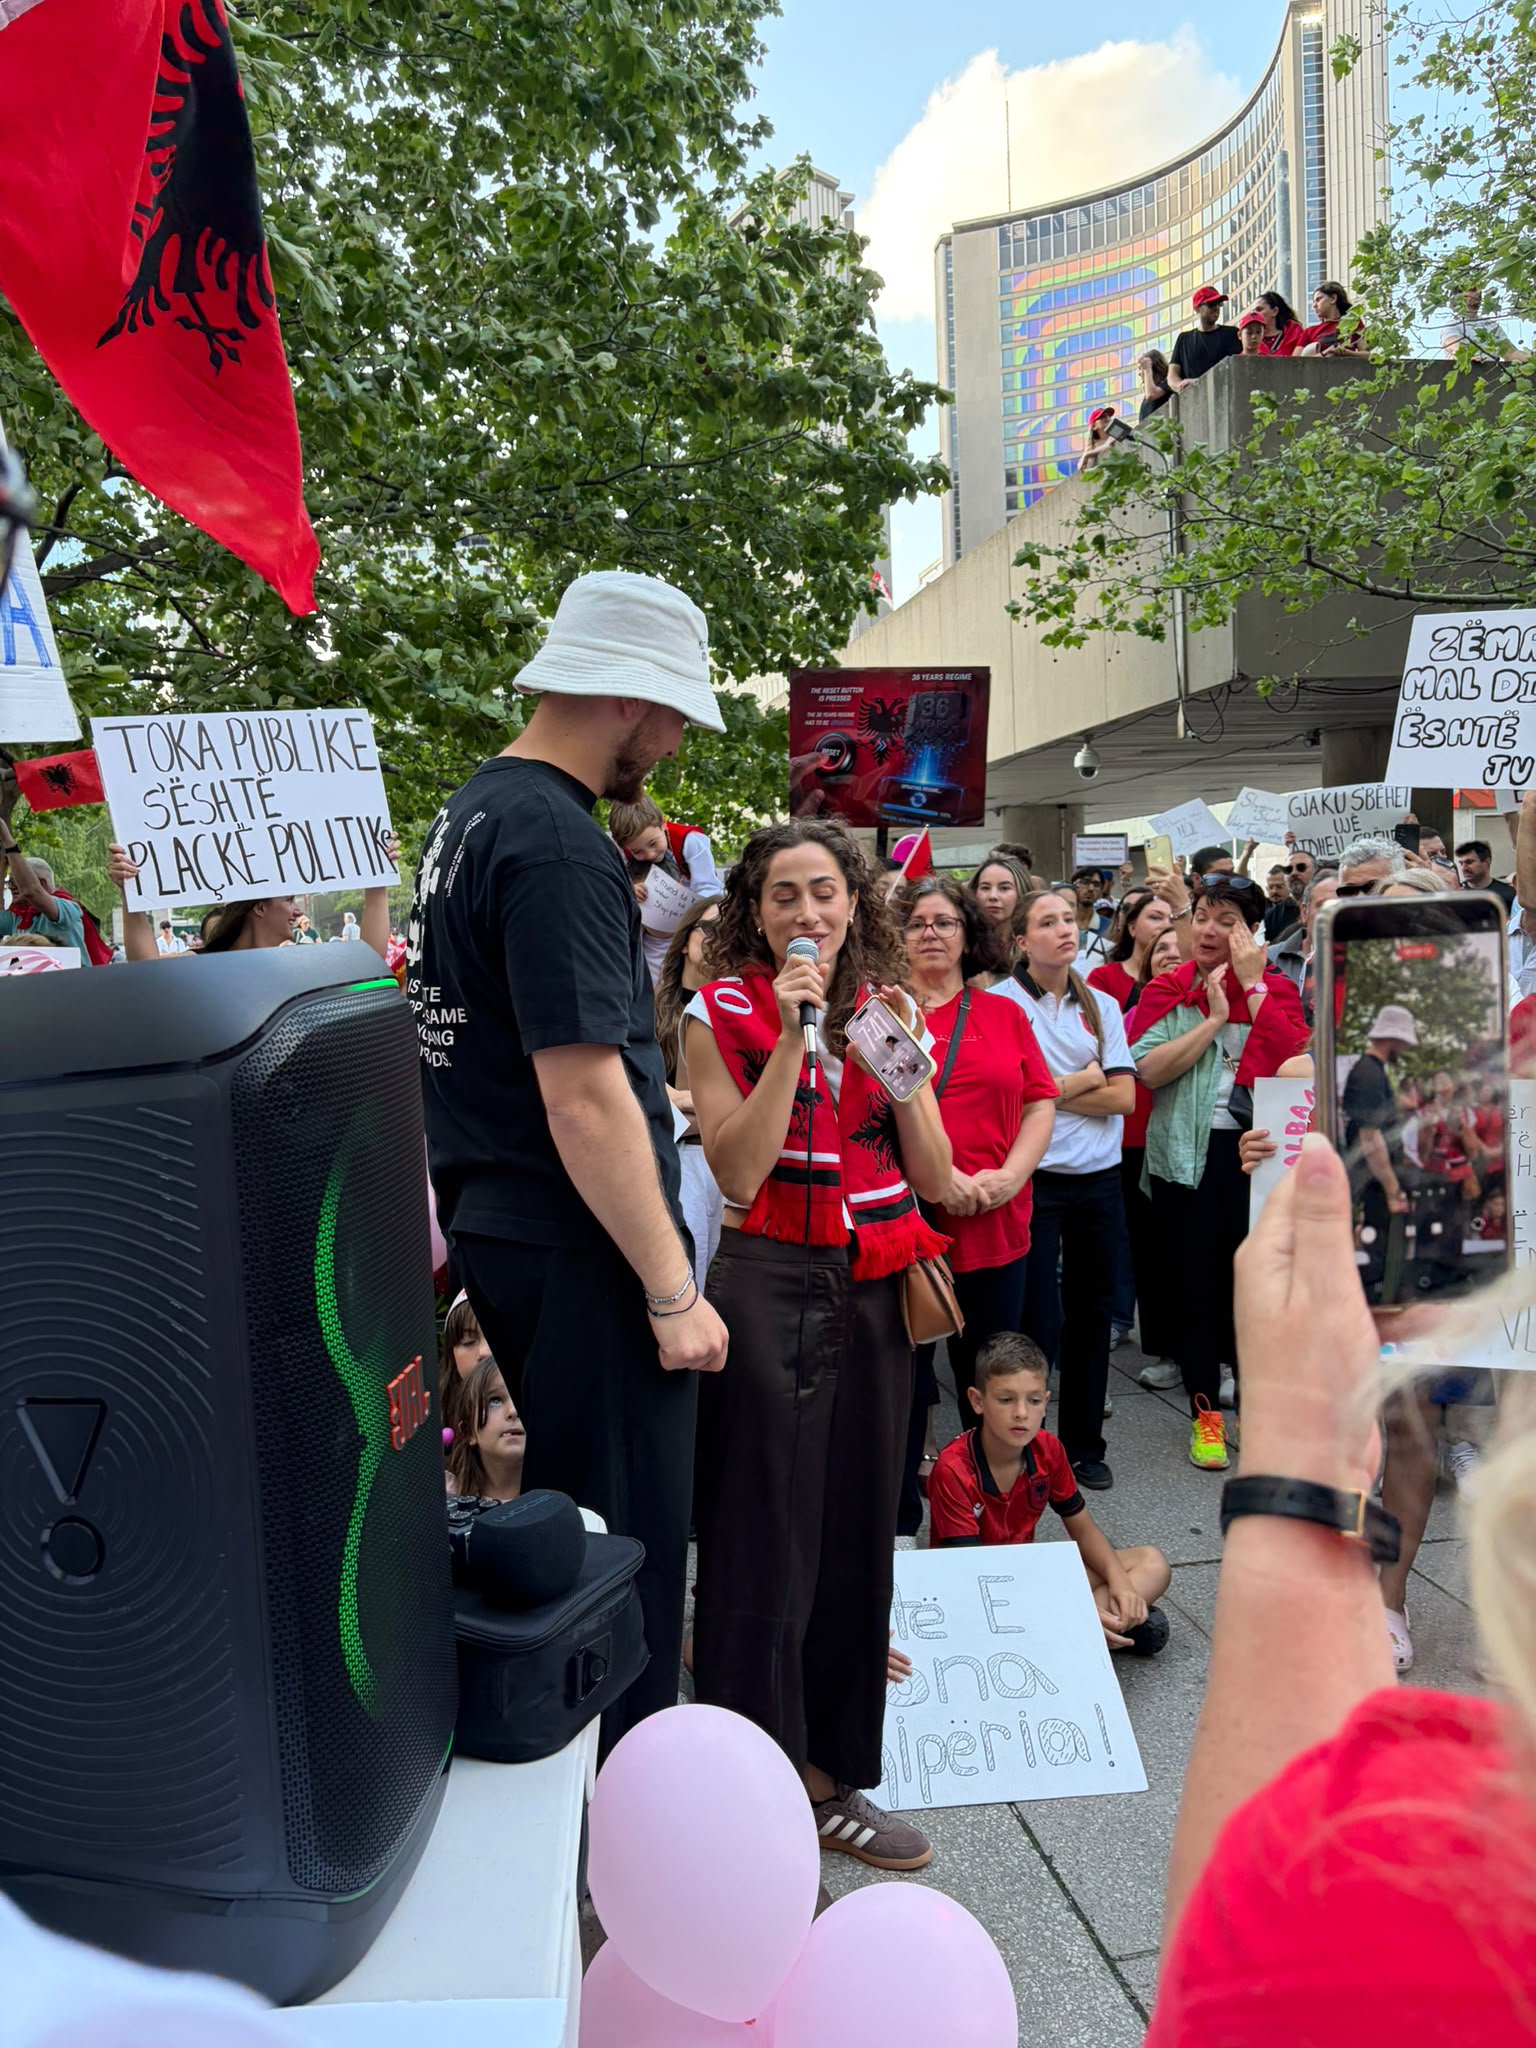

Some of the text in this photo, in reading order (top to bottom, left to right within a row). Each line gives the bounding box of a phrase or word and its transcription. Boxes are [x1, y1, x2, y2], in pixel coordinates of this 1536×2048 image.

[840, 686, 864, 694] BUTTON
[922, 673, 944, 681] YEARS
[945, 672, 973, 681] REGIME
[1402, 665, 1482, 701] MAL
[920, 698, 950, 717] 36
[103, 713, 378, 777] TOKA PUBLIKE
[1397, 706, 1520, 750] ËSHTË
[1288, 791, 1346, 818] GJAKU
[127, 822, 269, 901] PLAÇKË
[386, 1355, 430, 1452] JBL
[978, 1575, 1026, 1635] E
